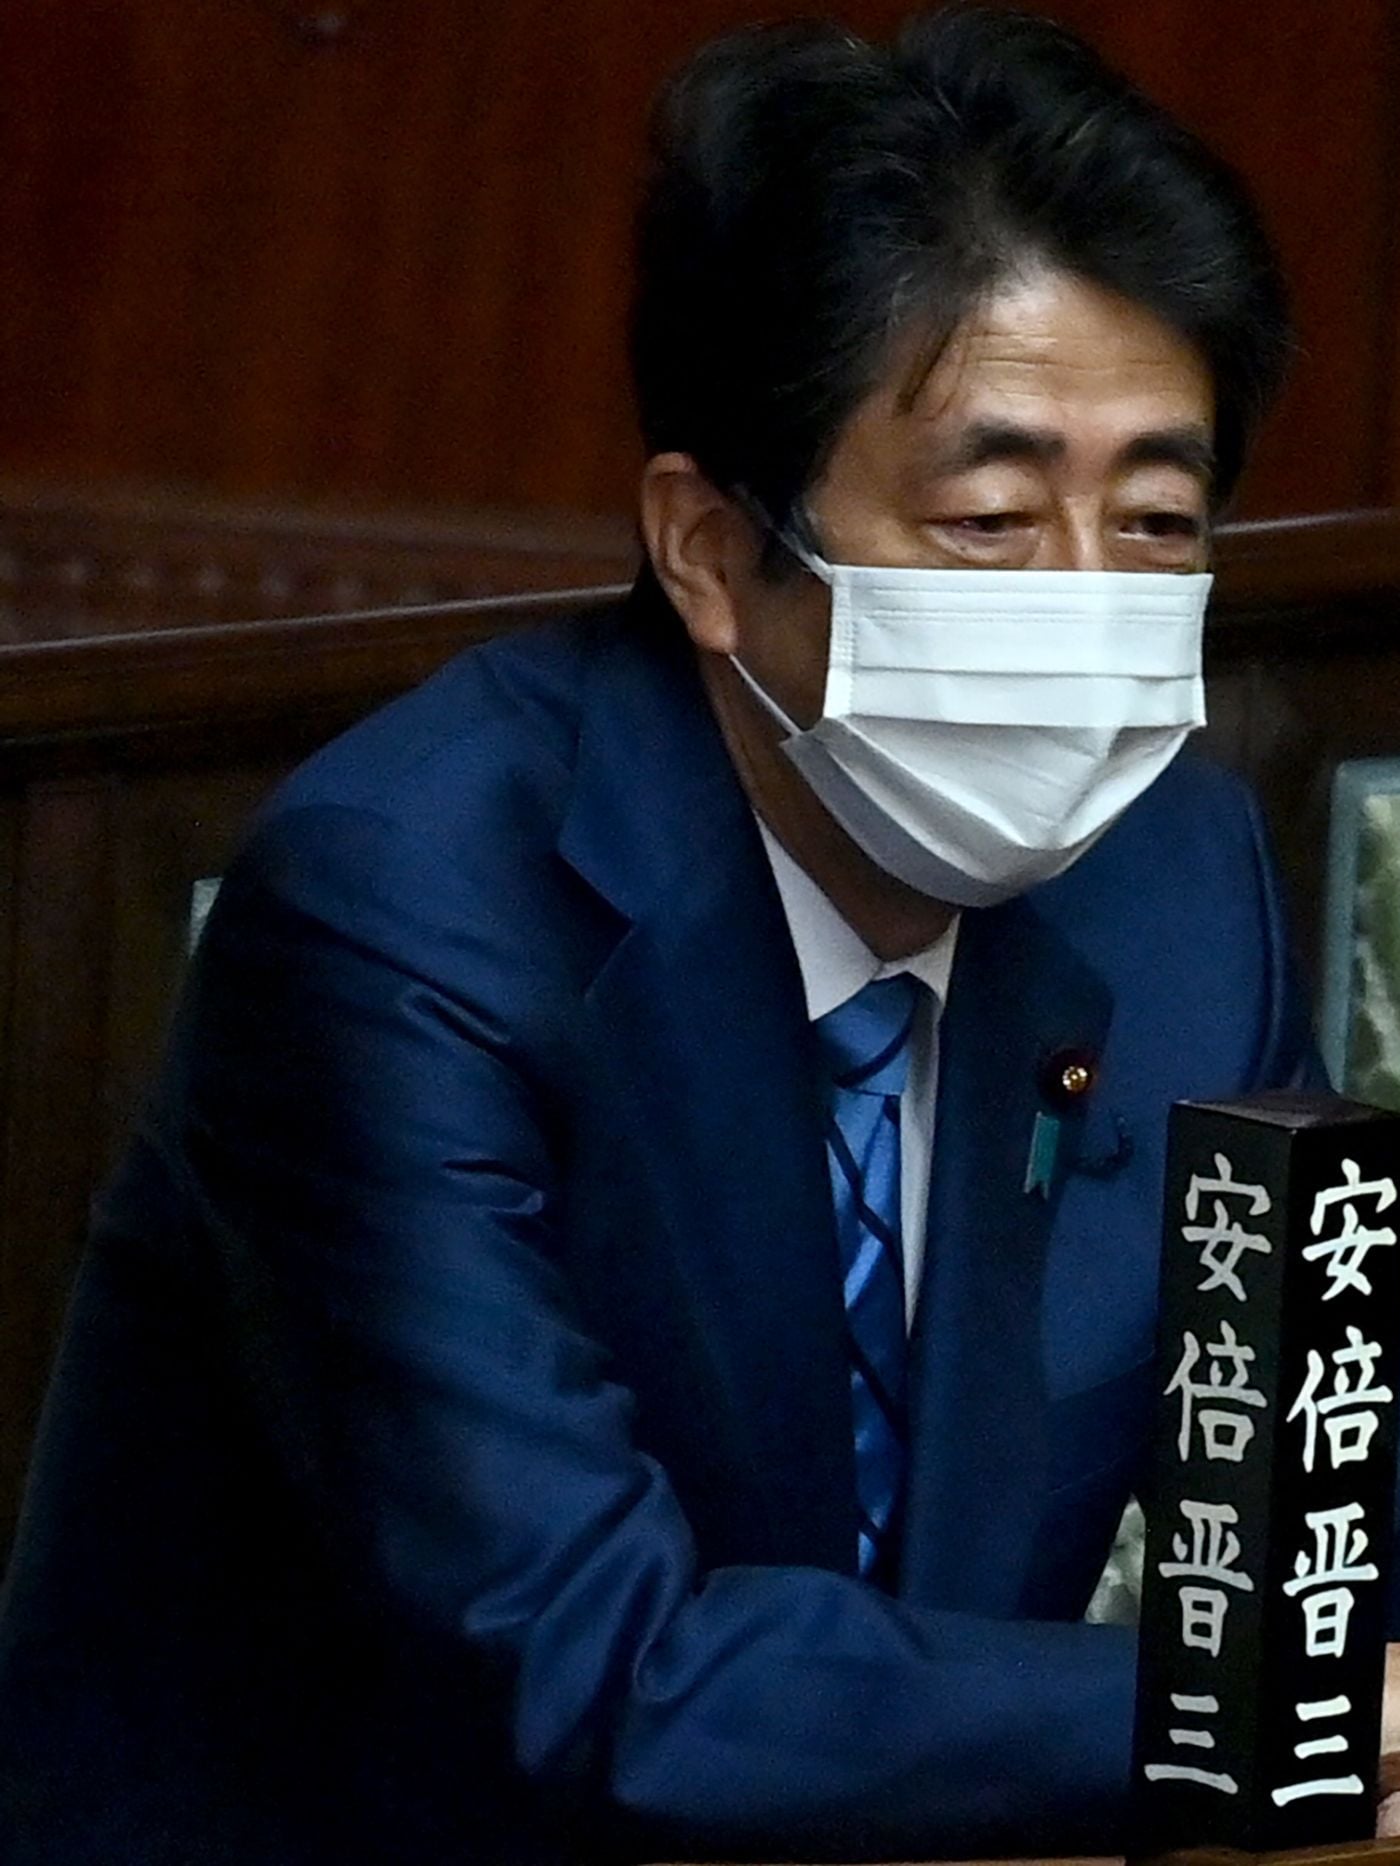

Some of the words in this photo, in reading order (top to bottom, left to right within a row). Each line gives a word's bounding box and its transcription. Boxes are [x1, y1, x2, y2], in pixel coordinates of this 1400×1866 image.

[1144, 1152, 1272, 1795] 安倍晋三
[1271, 1157, 1398, 1807] 安倍晋三
